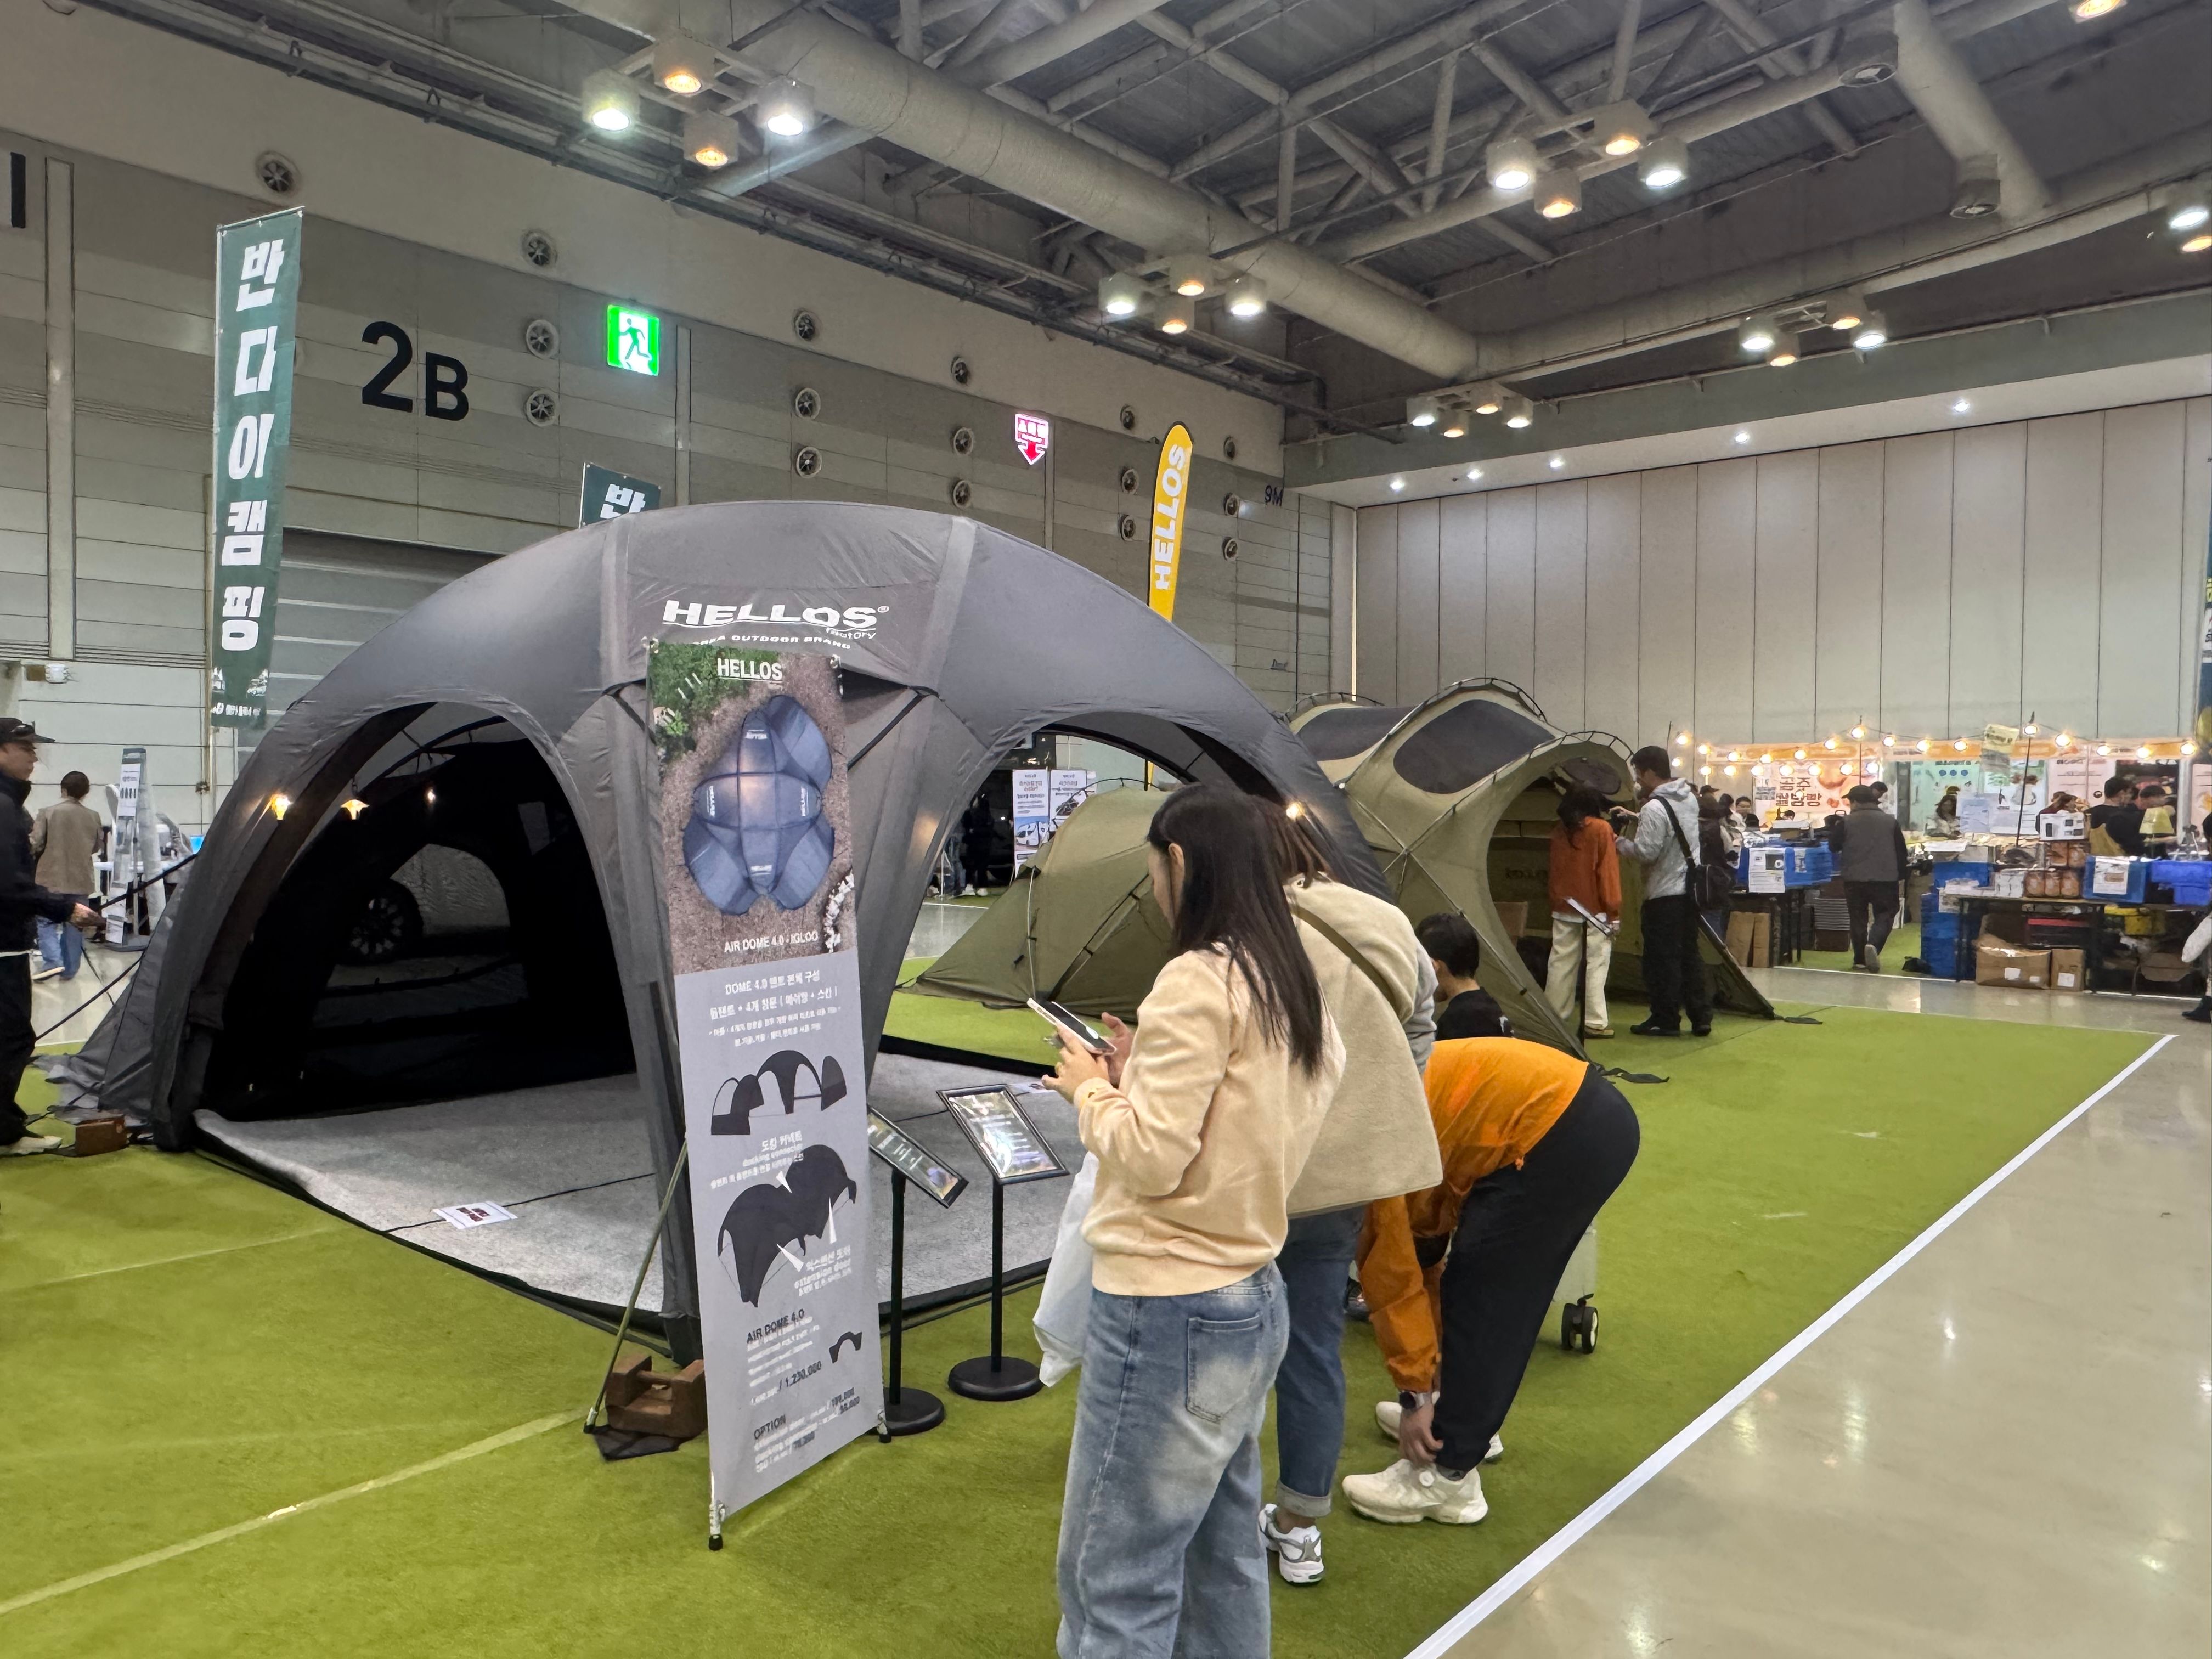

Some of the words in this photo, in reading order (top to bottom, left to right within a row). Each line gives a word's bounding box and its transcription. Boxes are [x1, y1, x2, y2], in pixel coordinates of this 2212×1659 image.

[362, 320, 469, 421] 2B
[221, 239, 284, 652] 반다이캠핑
[1154, 444, 1186, 590] HELLOS
[662, 600, 877, 629] HELLOS
[717, 658, 783, 680] HELLOS
[724, 940, 741, 953] AIR
[742, 936, 770, 950] DOME
[725, 980, 752, 995] DOME
[805, 969, 820, 983] 구성
[747, 1328, 762, 1344] AIR
[764, 1315, 789, 1335] DOME
[754, 1414, 786, 1440] OPTION
